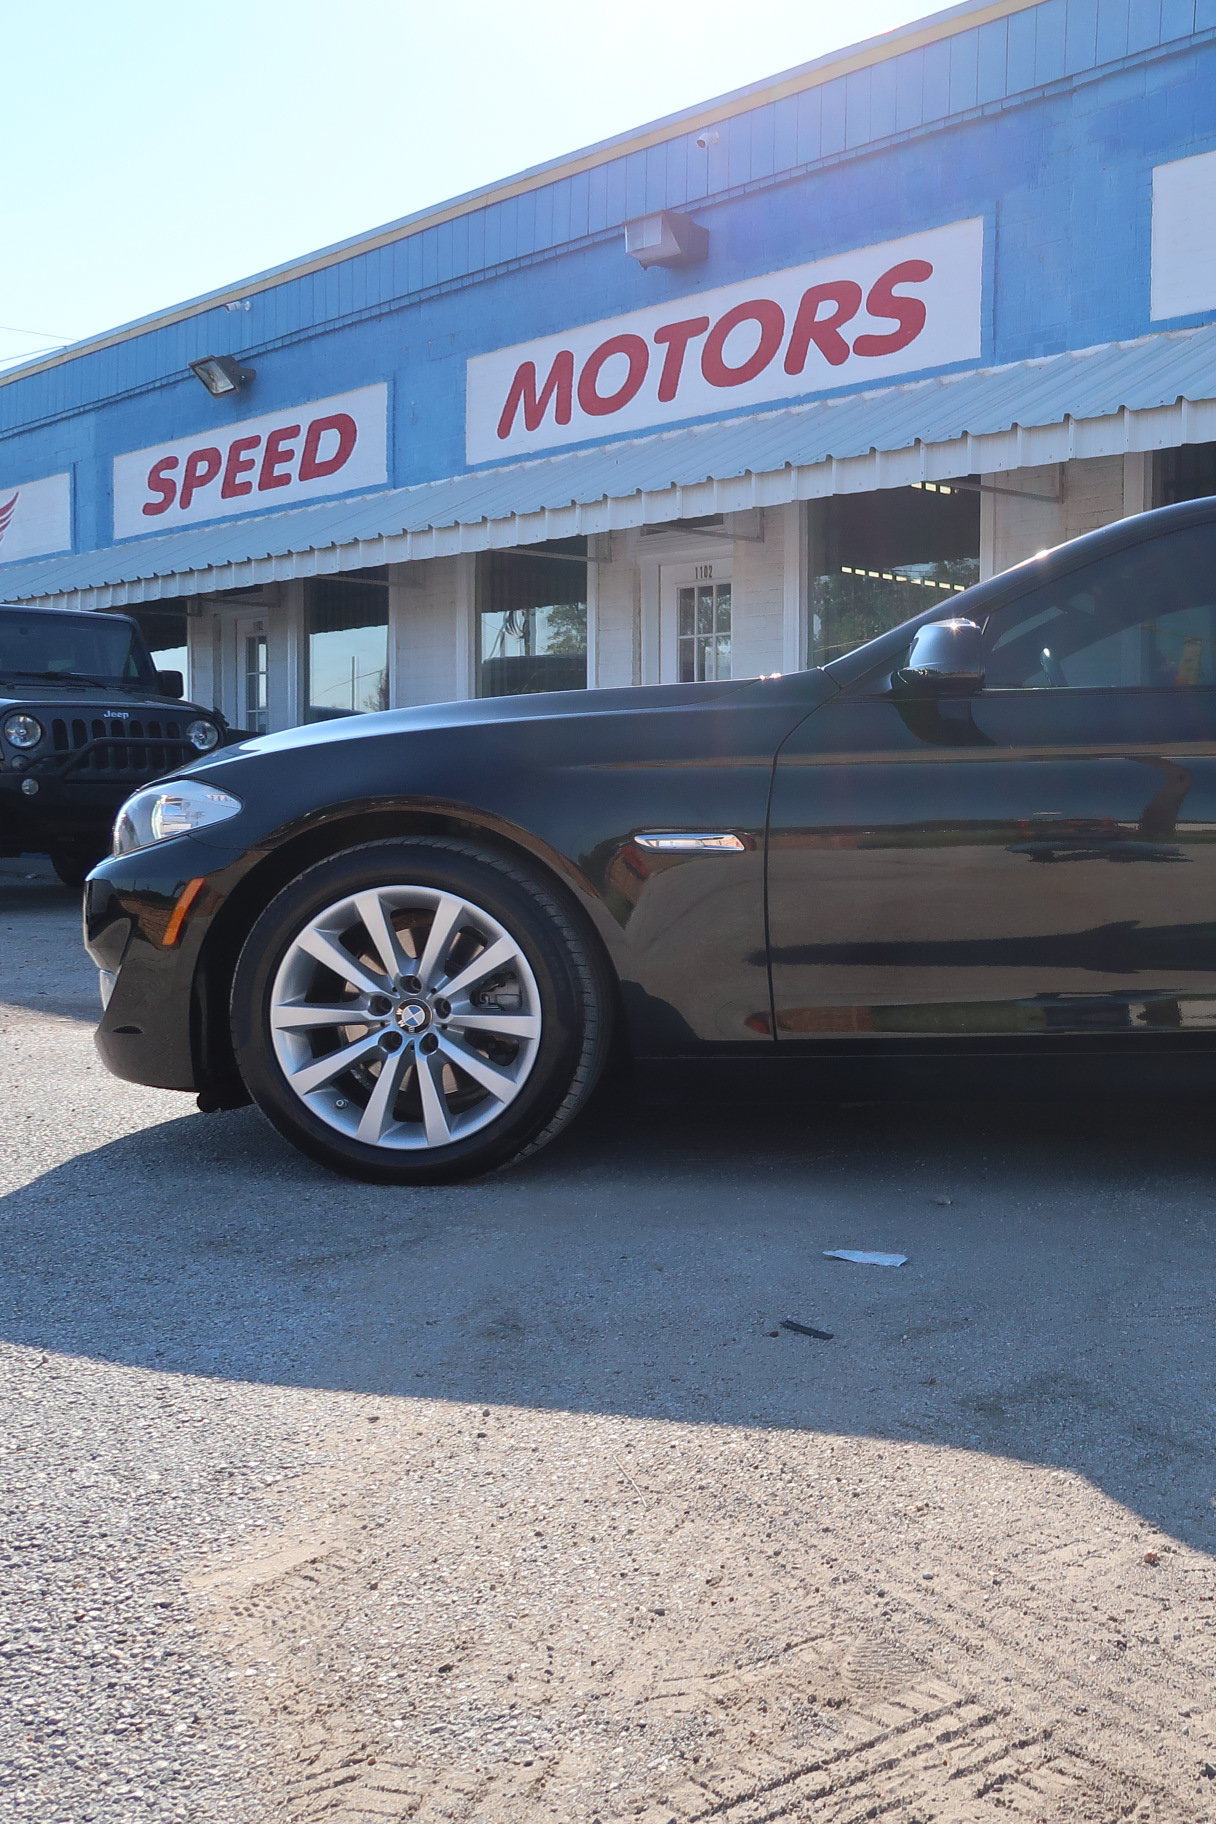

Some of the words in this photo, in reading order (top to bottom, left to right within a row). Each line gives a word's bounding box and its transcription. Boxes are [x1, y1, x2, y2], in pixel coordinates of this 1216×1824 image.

[498, 259, 932, 438] MOTORS
[142, 413, 357, 516] SPEED
[695, 565, 713, 580] 1102
[103, 710, 130, 720] Jeep
